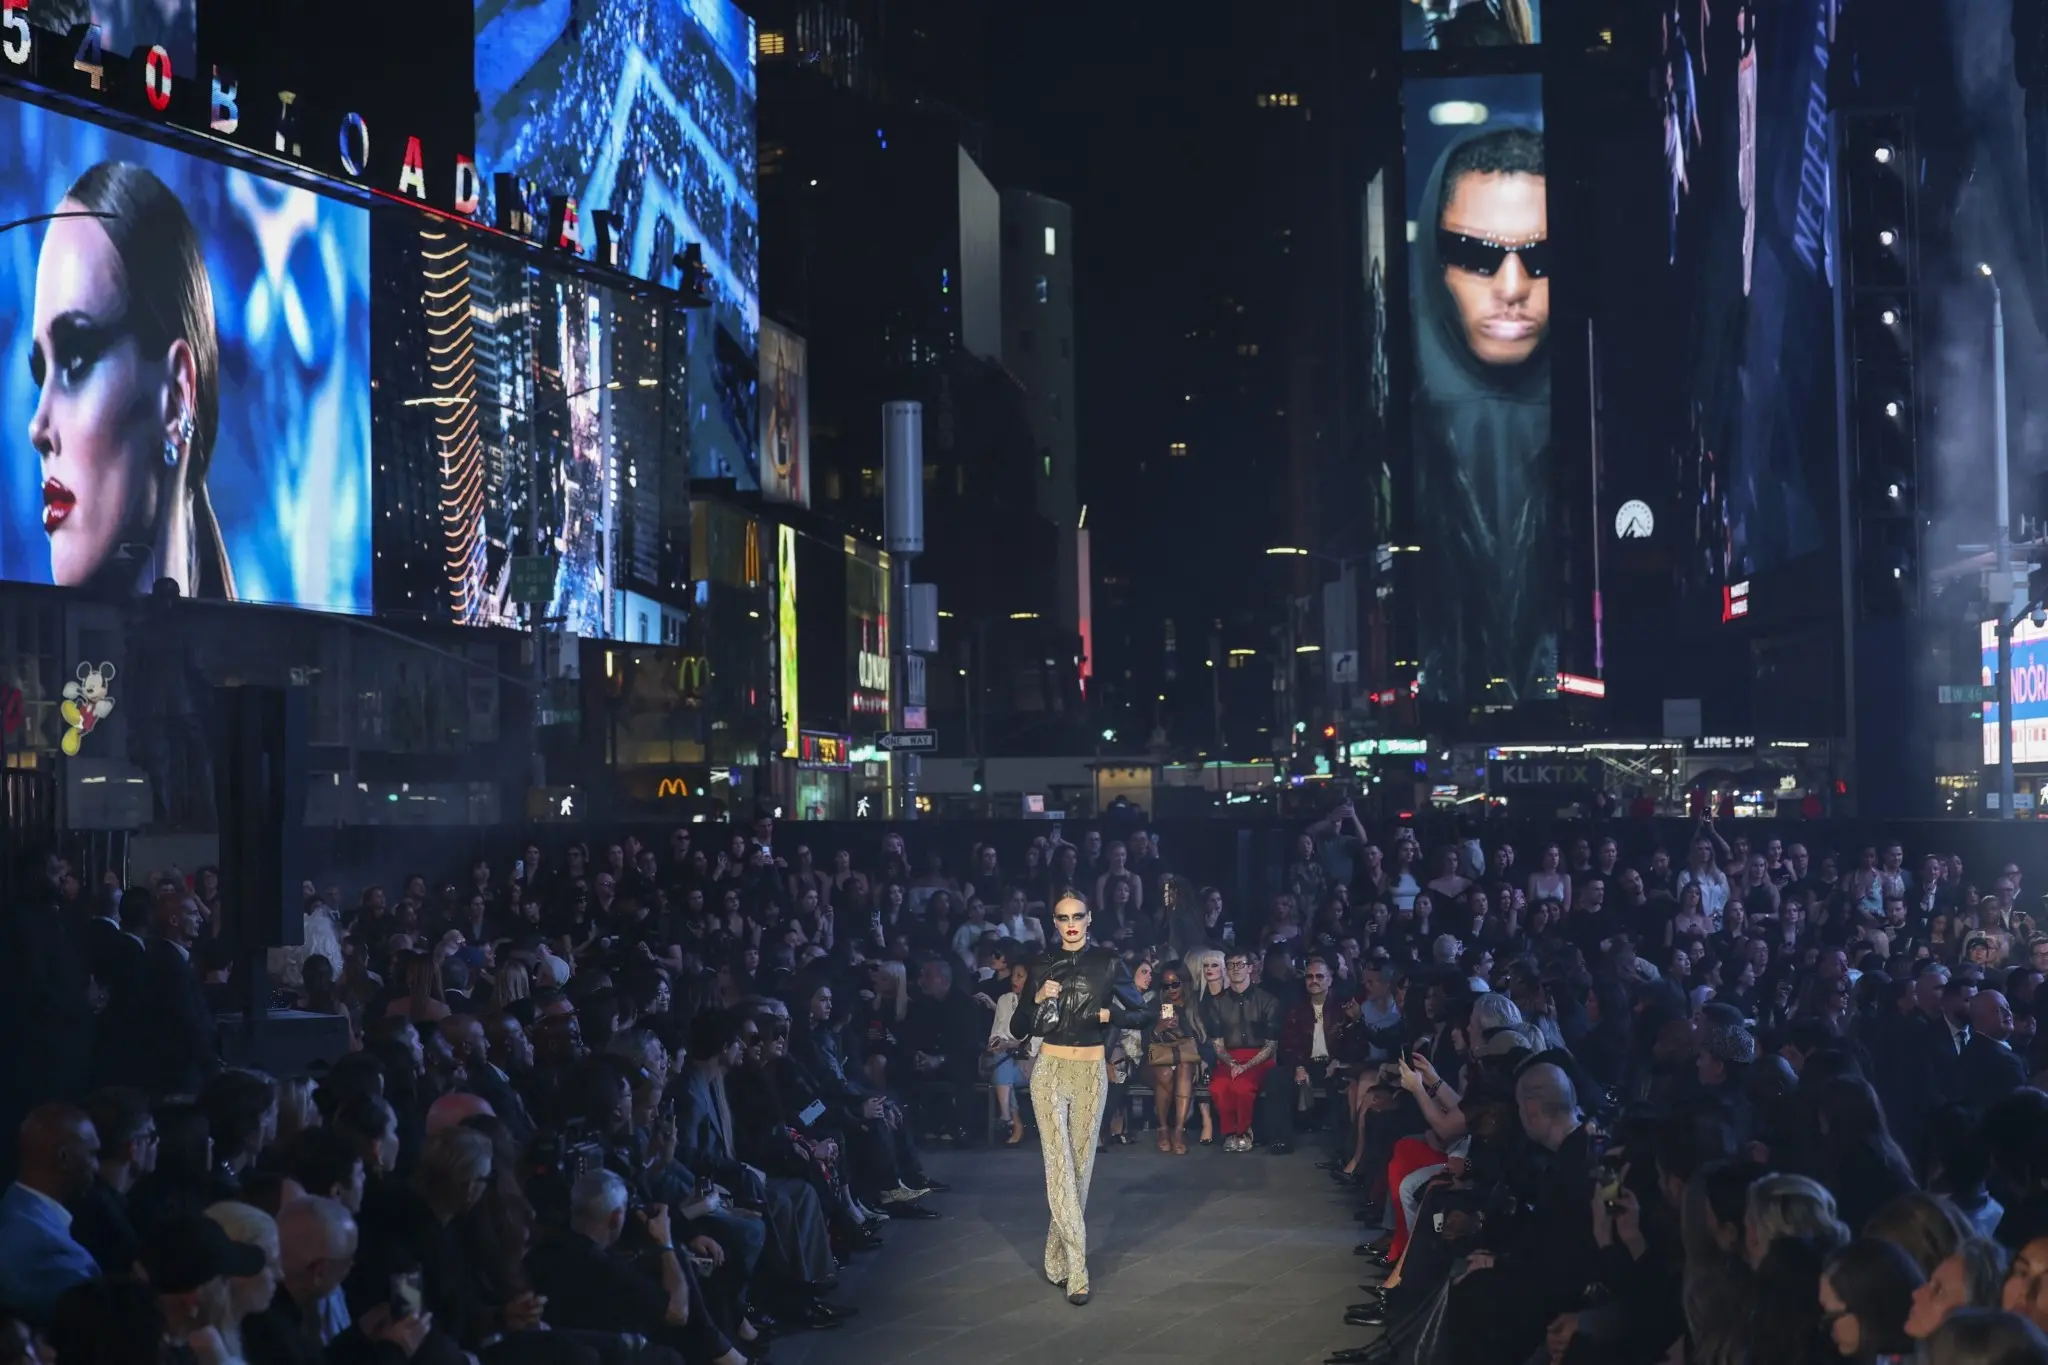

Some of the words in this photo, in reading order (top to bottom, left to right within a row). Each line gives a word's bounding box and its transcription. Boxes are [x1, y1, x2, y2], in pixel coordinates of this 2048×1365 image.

[884, 736, 902, 746] ONE
[910, 736, 928, 745] WAY
[1502, 764, 1589, 784] KLIKTIX
